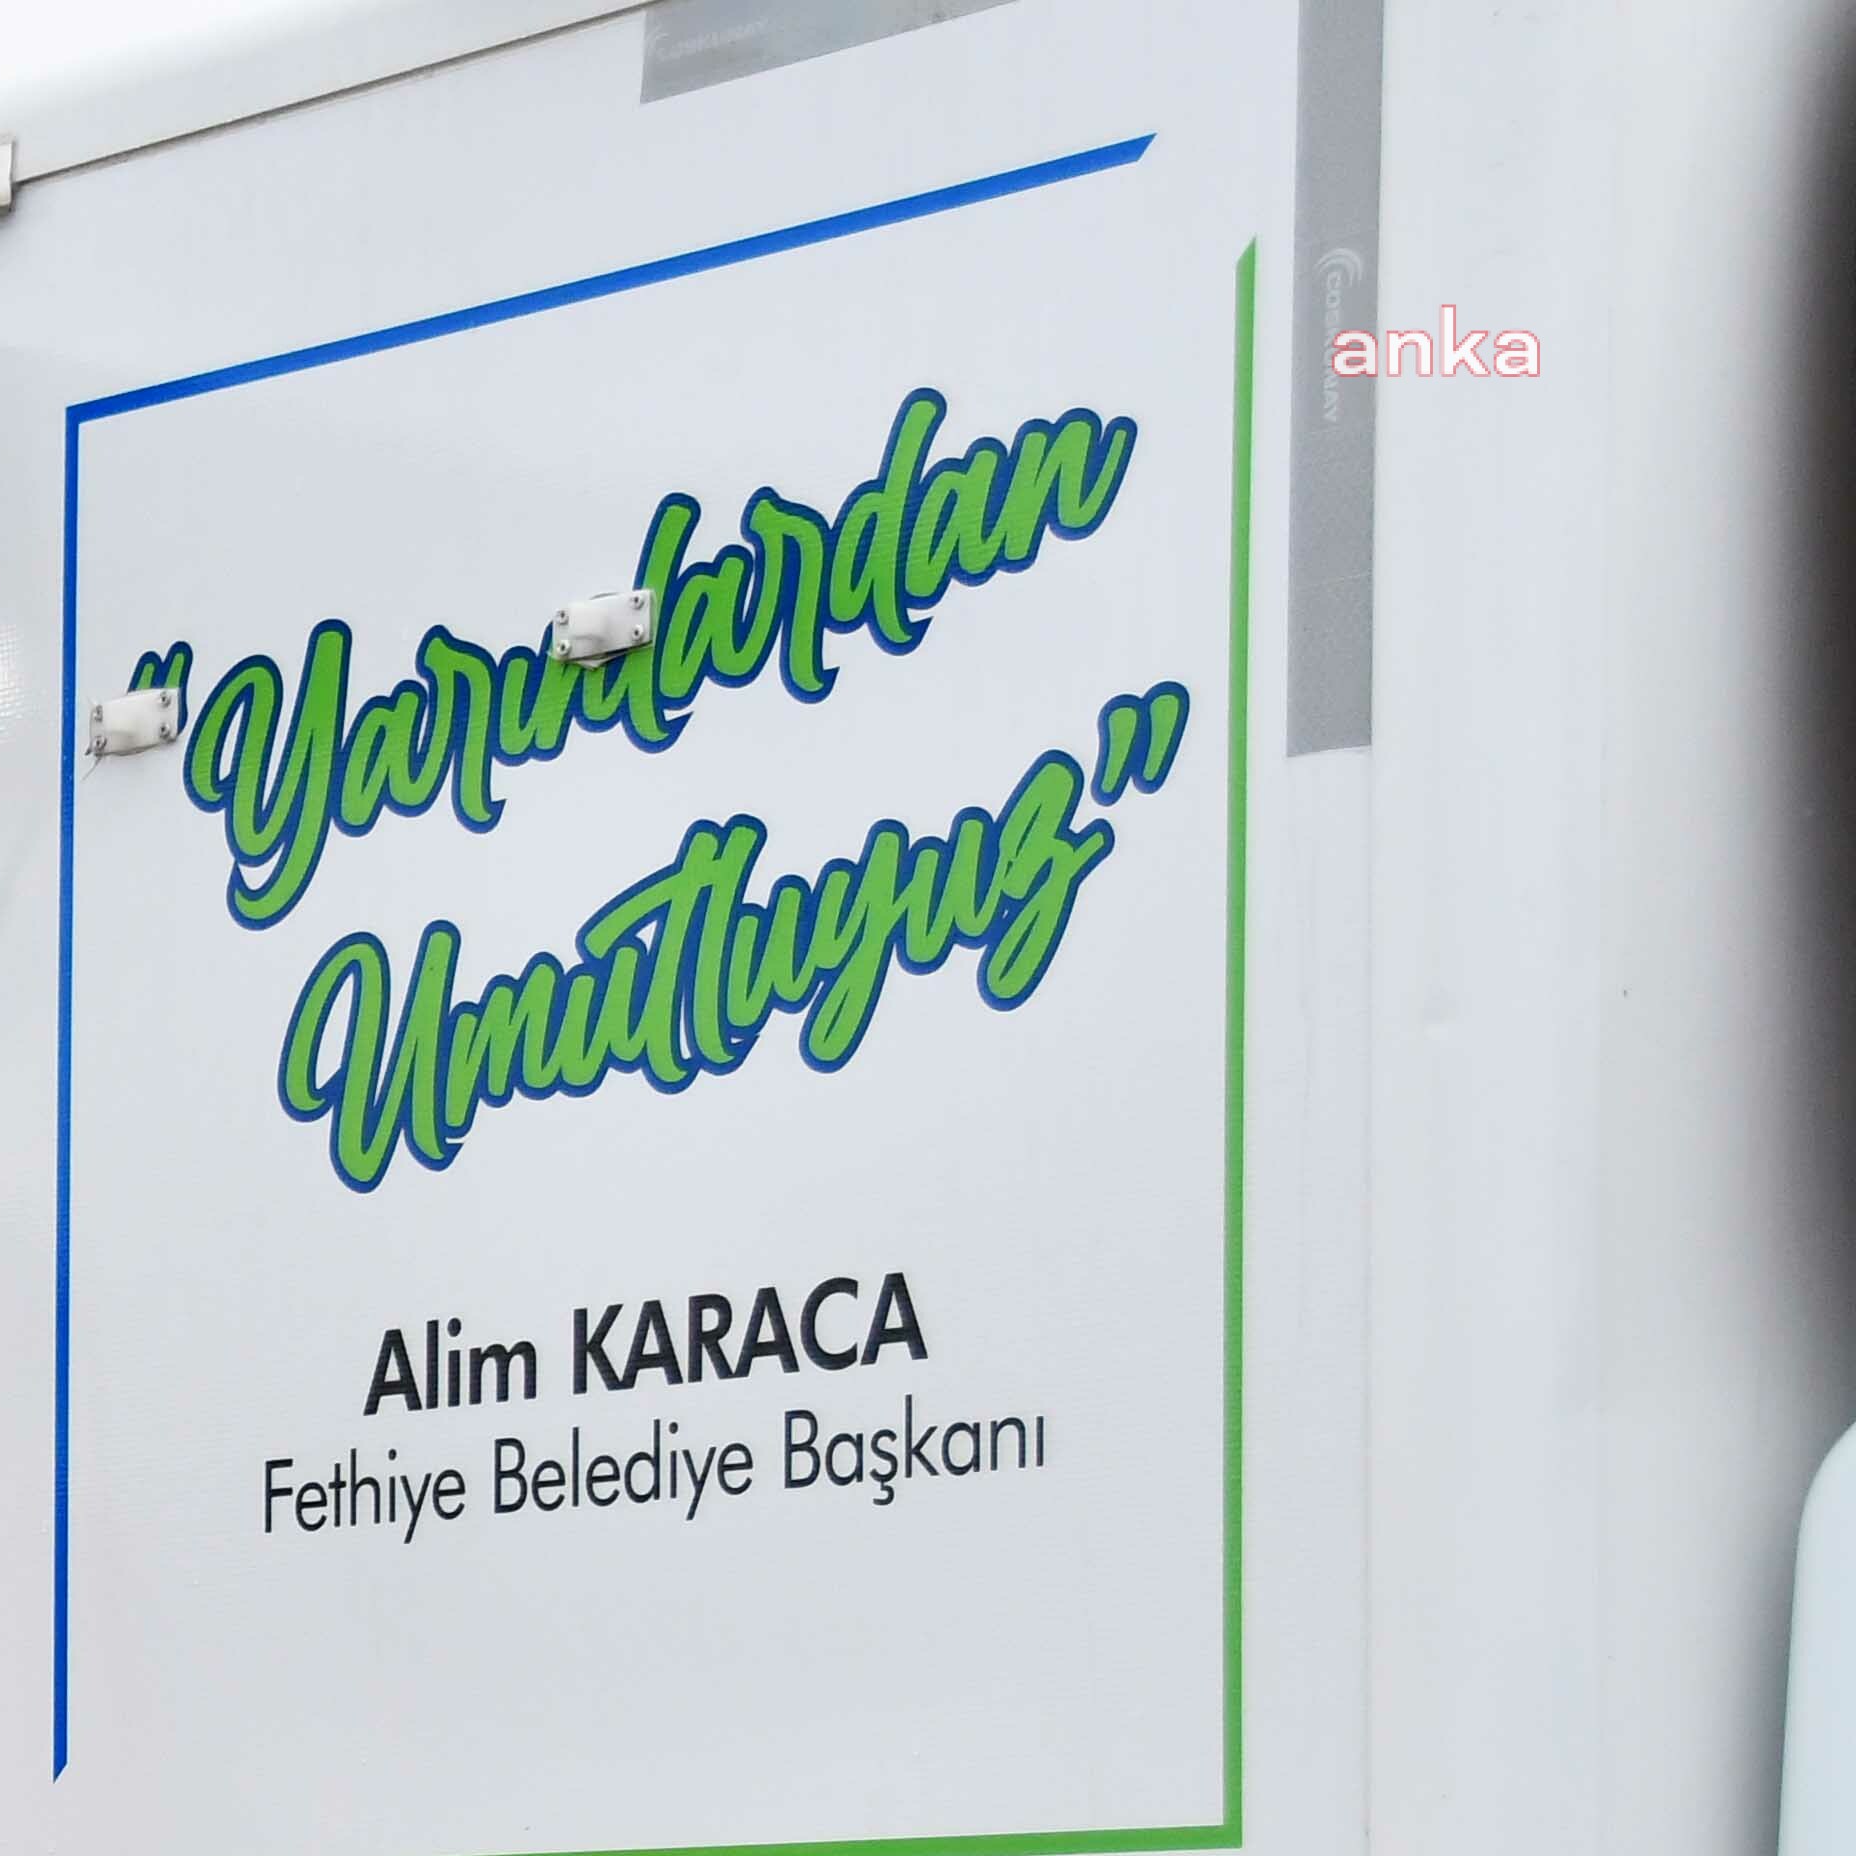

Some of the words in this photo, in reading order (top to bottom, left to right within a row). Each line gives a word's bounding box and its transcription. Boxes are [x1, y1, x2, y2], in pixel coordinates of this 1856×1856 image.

[363, 1317, 537, 1416] Alim
[573, 1272, 929, 1396] KARACA
[264, 1448, 466, 1545] Fethiye
[494, 1418, 754, 1515] Belediye
[784, 1394, 1045, 1506] Başkanı
